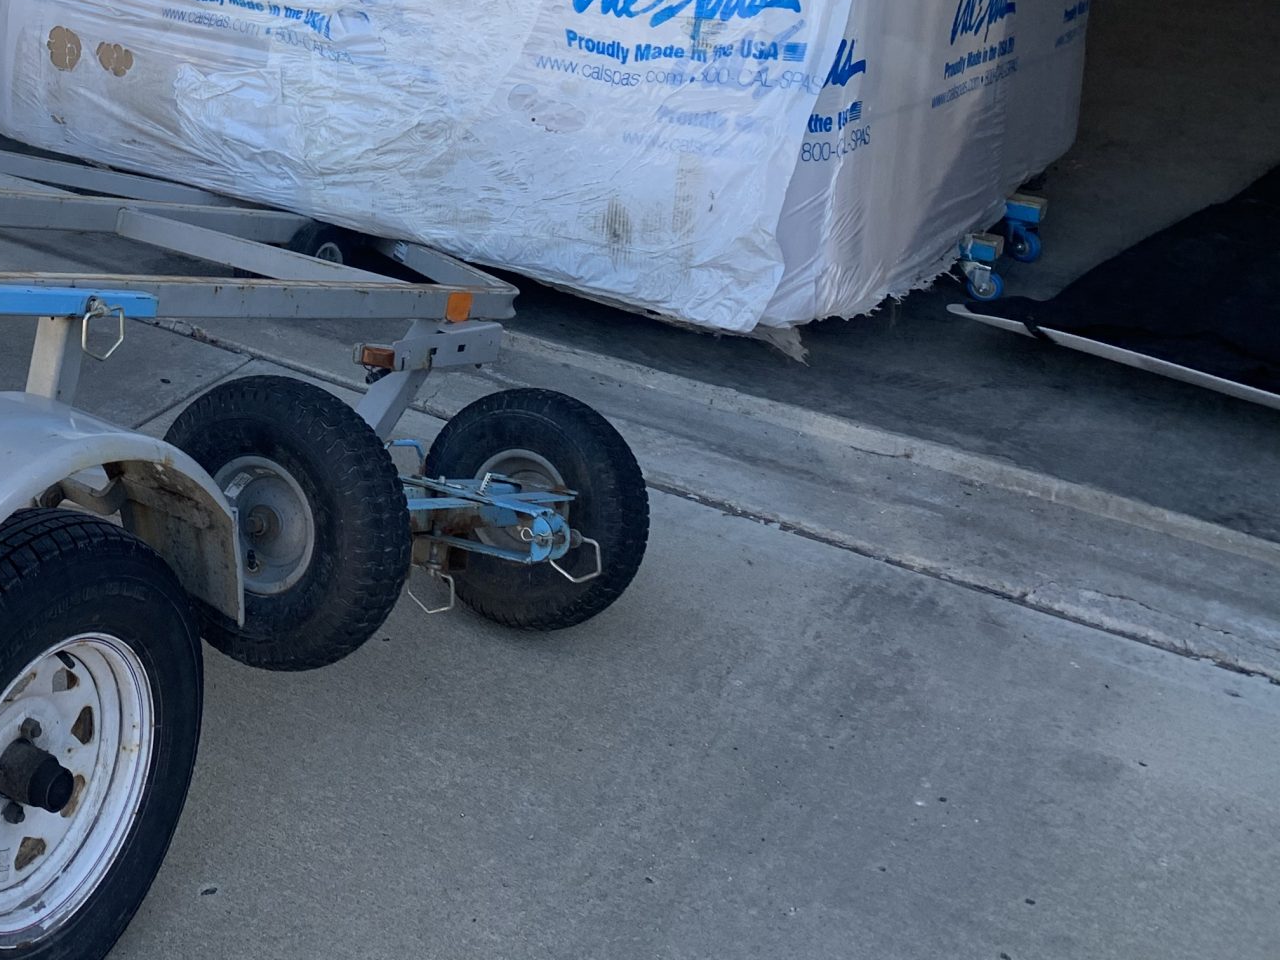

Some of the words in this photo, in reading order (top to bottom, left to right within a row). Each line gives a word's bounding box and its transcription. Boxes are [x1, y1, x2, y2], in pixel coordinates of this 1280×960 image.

[161, 6, 262, 37] www.calspas.com
[267, 0, 281, 17] in
[565, 28, 629, 65] Proudly
[634, 43, 685, 63] Made
[690, 39, 708, 64] in
[740, 38, 779, 61] USA
[807, 113, 833, 134] the
[801, 125, 872, 162] 800-CL-SPAS
